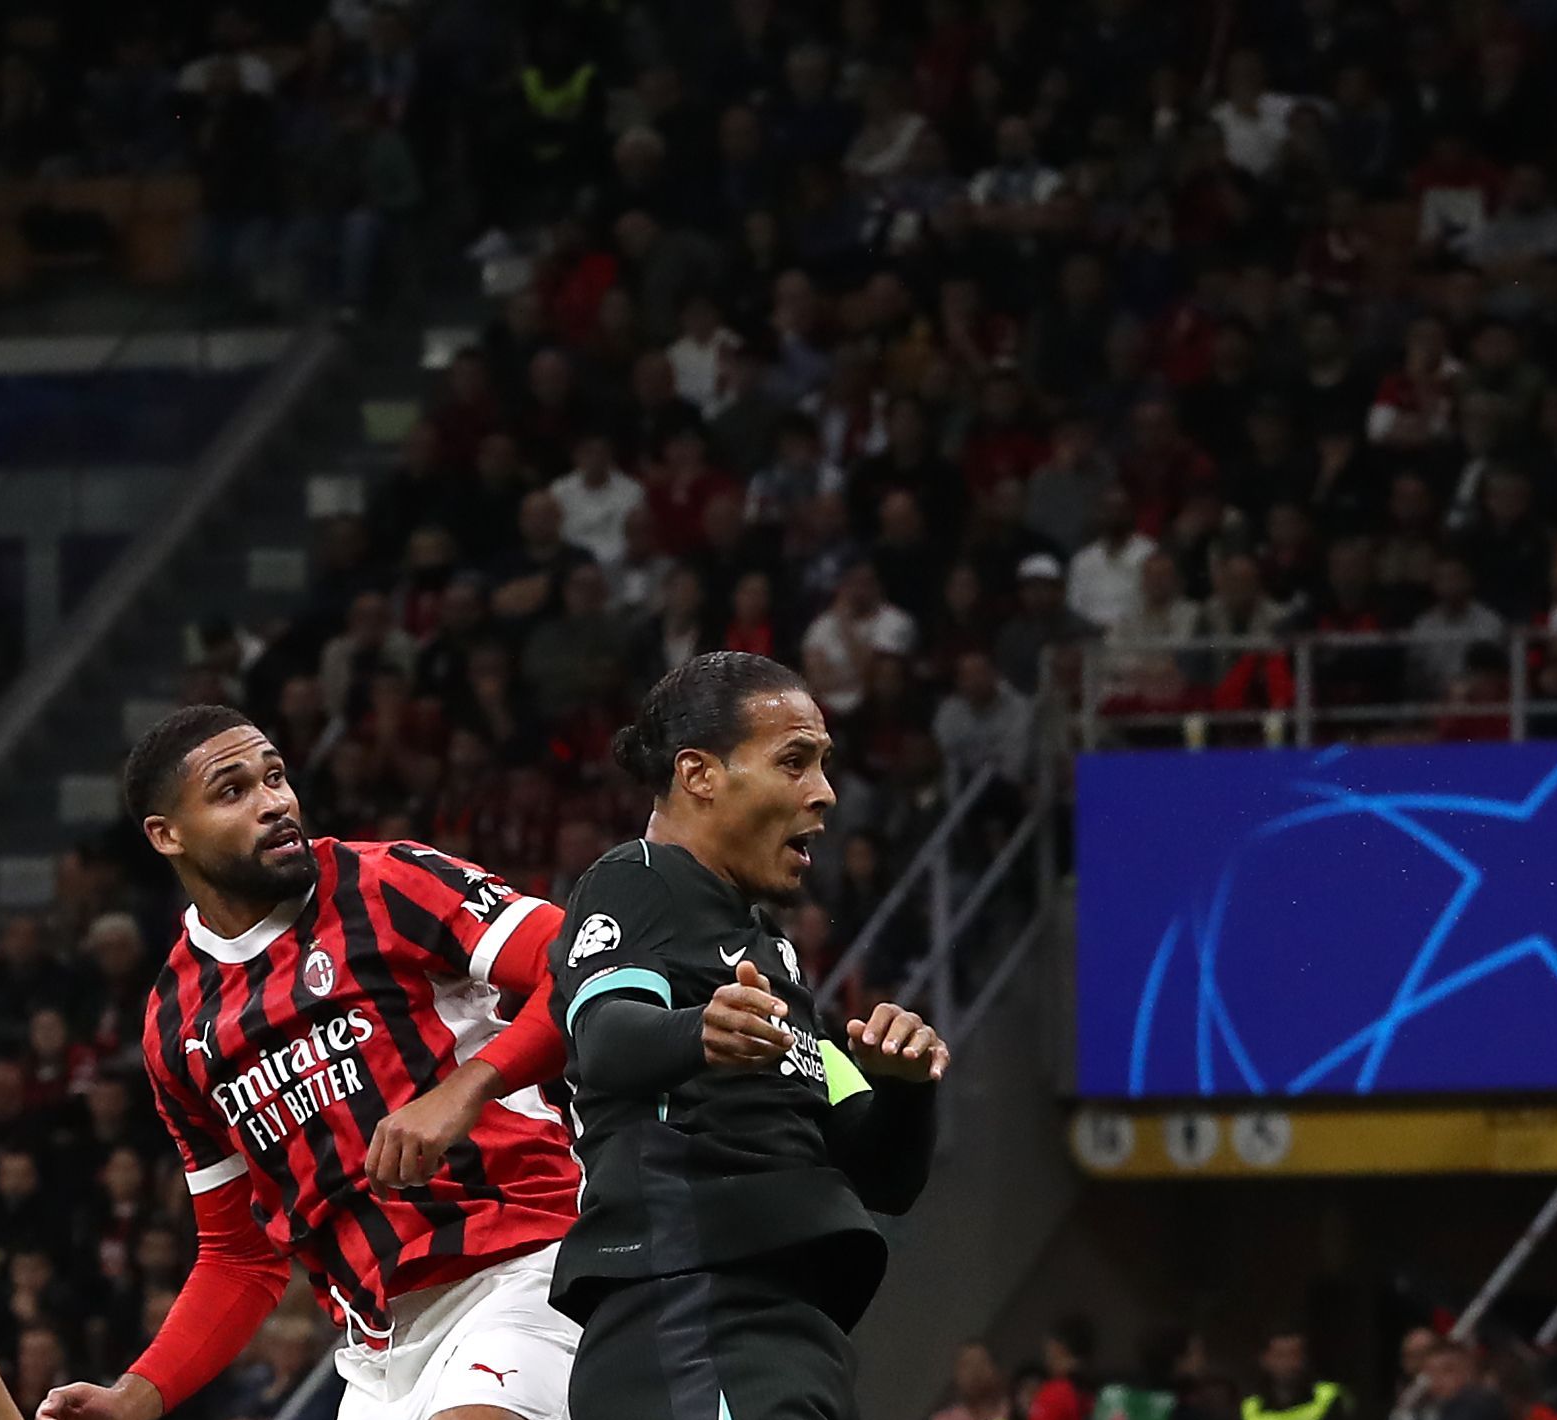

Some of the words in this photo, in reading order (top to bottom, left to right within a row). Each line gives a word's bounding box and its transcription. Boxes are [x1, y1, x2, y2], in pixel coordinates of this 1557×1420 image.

[211, 1008, 373, 1127] Emirates
[245, 1102, 288, 1151] FLY
[282, 1057, 364, 1126] BETTER
